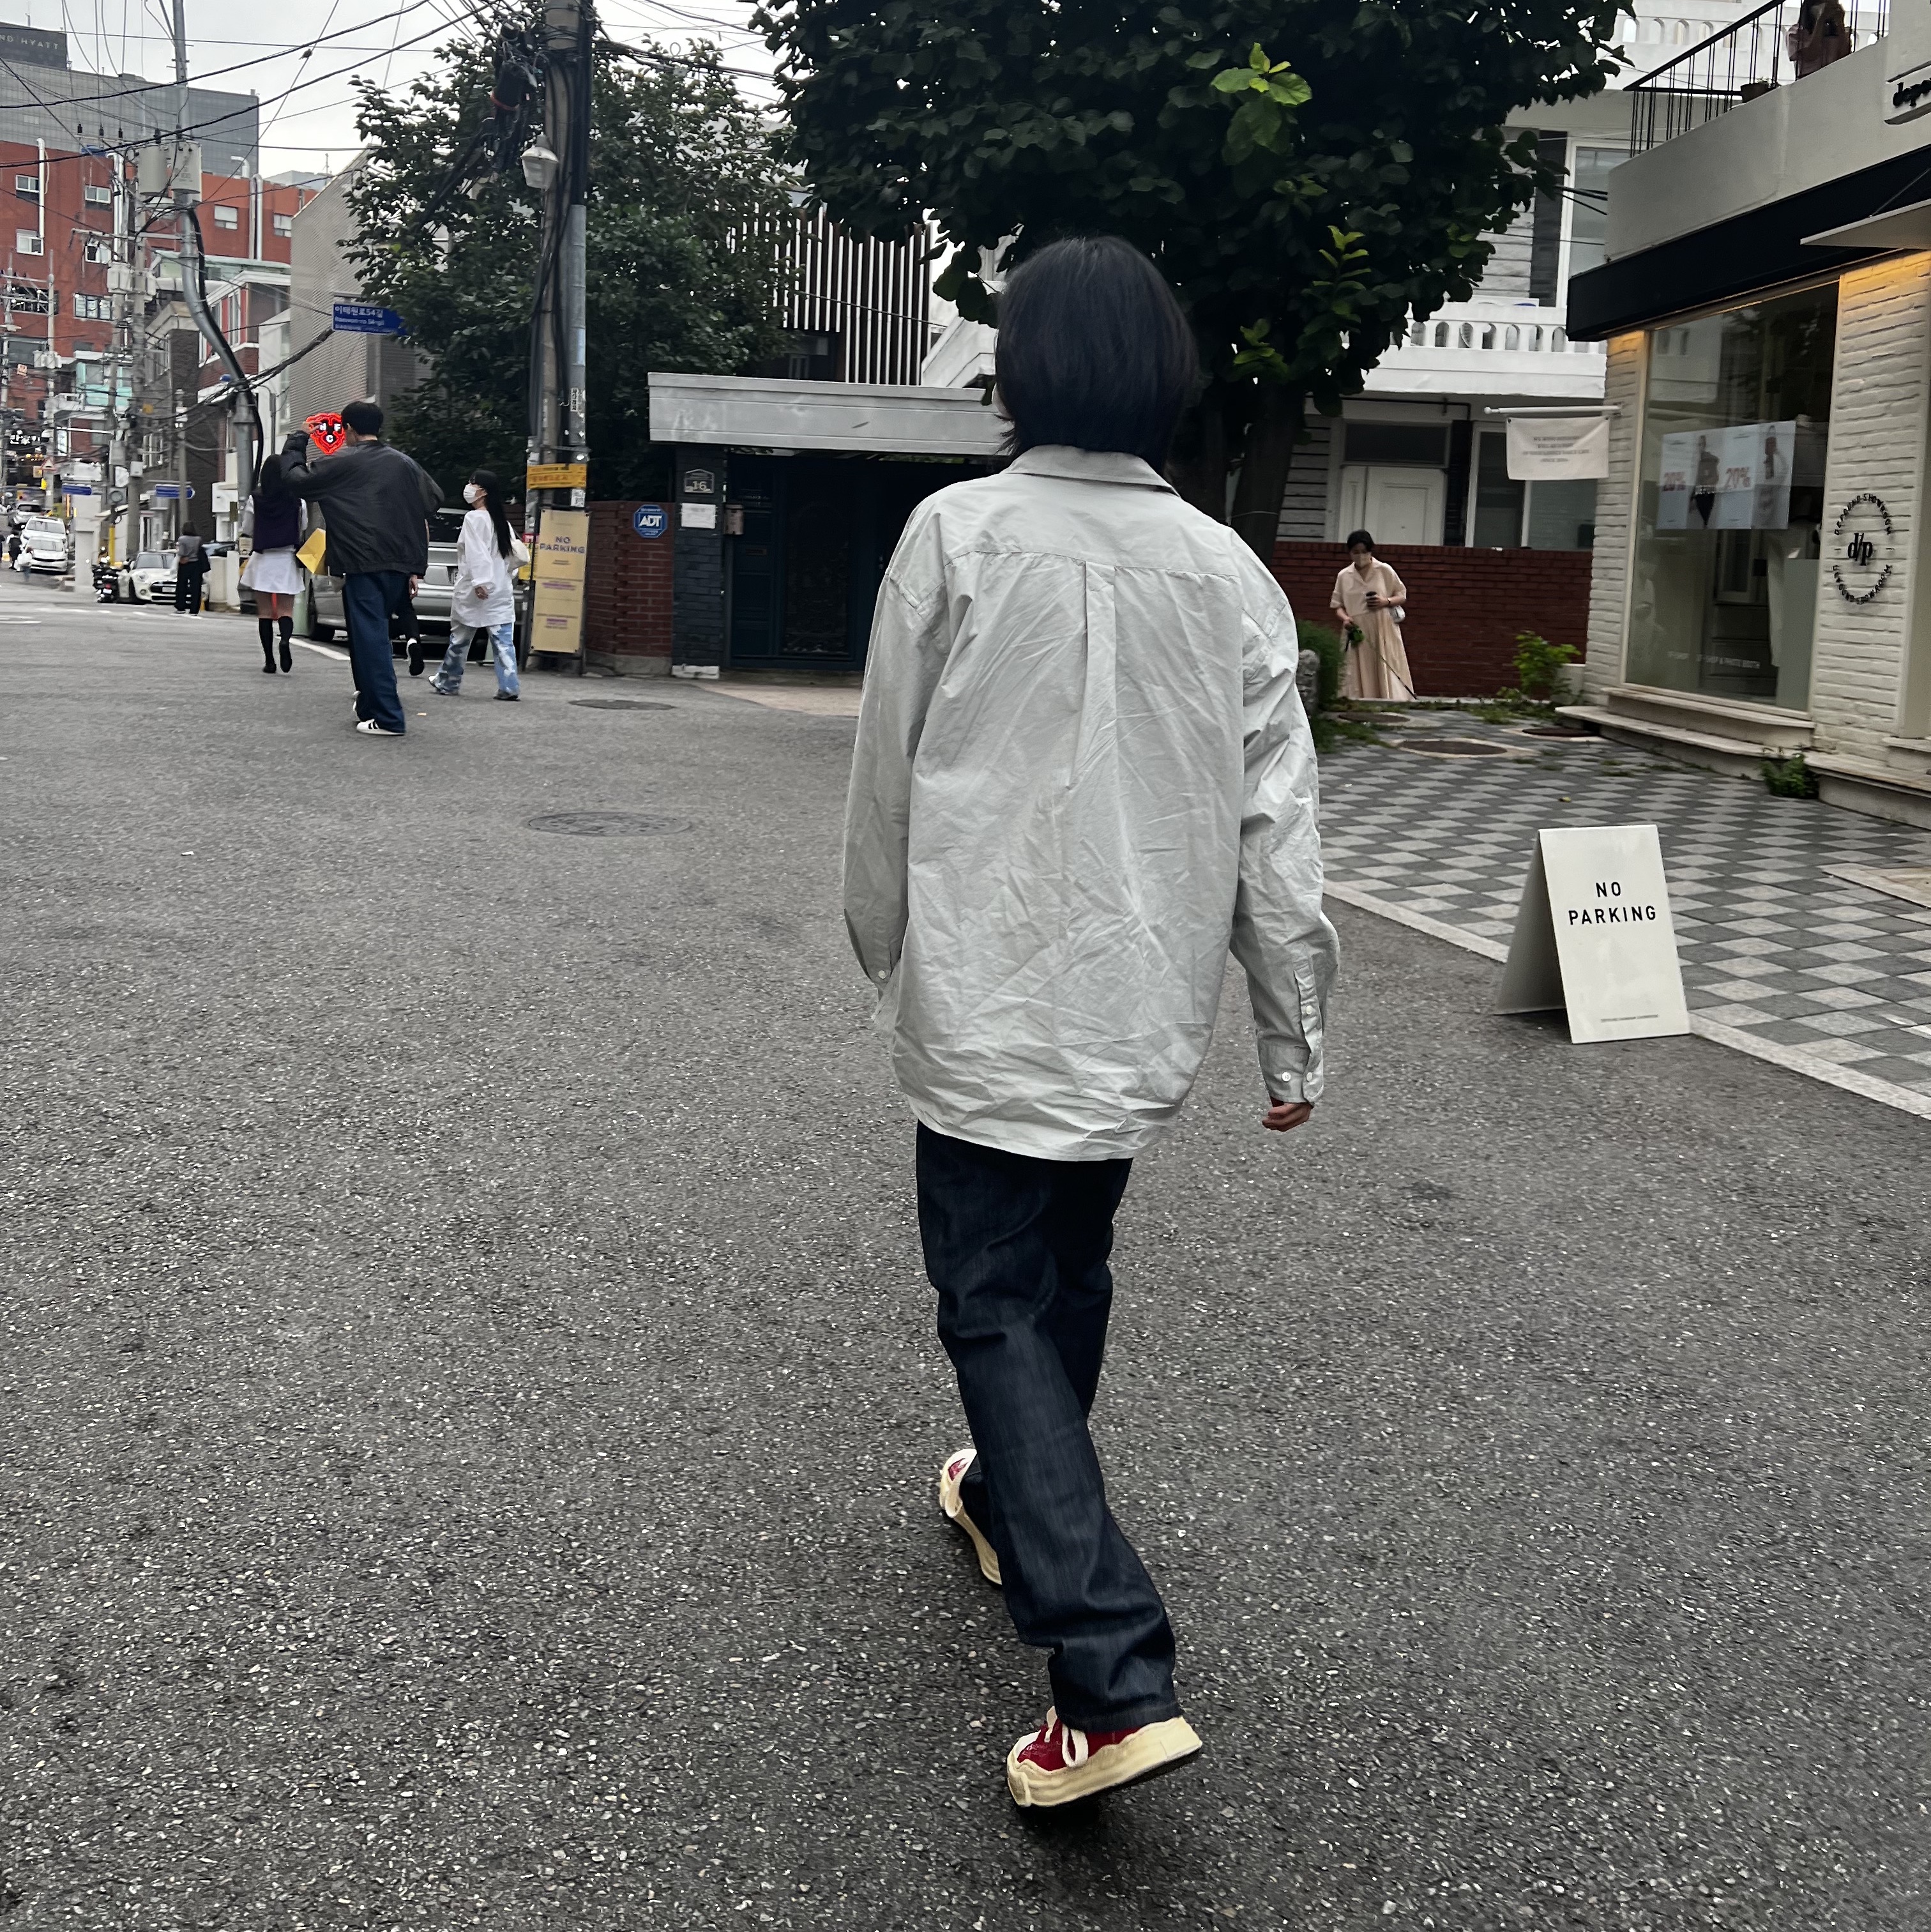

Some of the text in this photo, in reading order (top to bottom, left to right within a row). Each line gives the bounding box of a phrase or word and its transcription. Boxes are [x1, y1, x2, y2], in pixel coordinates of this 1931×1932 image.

[21, 38, 59, 49] HYATT
[1893, 78, 1931, 107] depo
[335, 306, 383, 318] 이태원로54길
[693, 481, 706, 491] 16
[639, 515, 662, 527] ADT
[540, 543, 586, 554] PARKING
[1596, 881, 1621, 897] NO
[1568, 905, 1656, 925] PARKING
